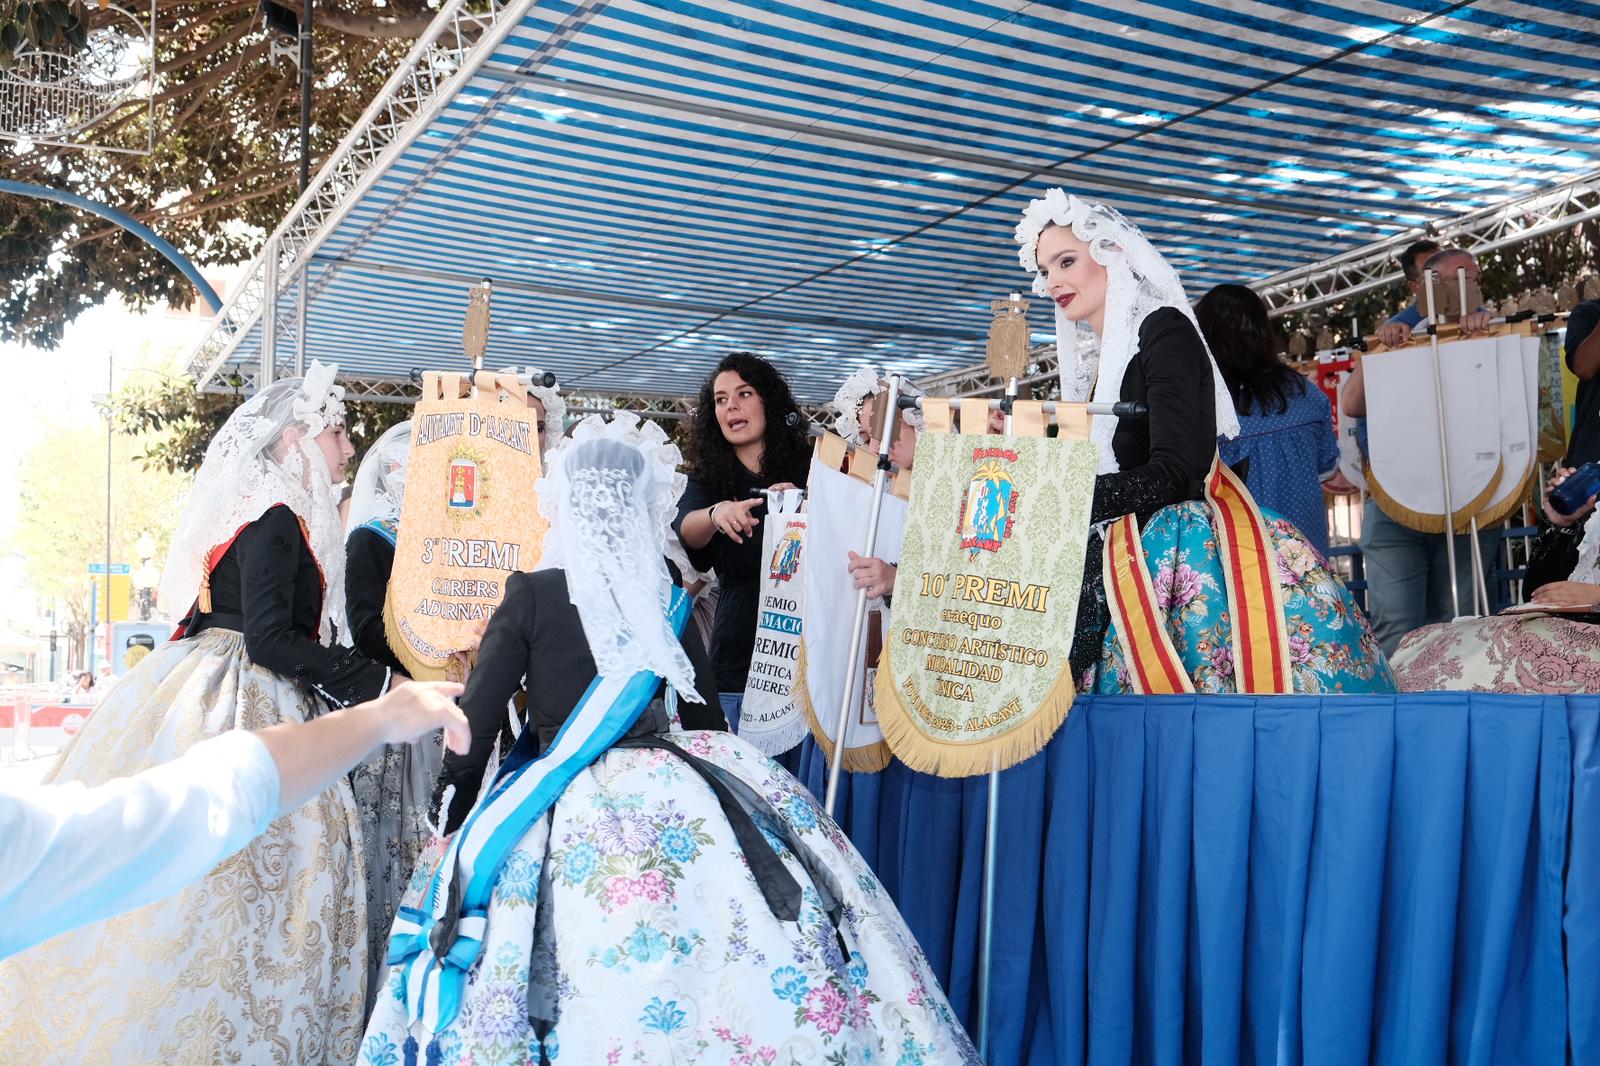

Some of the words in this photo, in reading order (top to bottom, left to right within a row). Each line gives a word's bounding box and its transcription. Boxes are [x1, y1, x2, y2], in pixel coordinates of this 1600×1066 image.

[951, 573, 1050, 613] PREMI
[958, 637, 1048, 668] ARTÍSTICO
[758, 701, 795, 723] ALACANT
[965, 698, 1022, 732] ALACANT
